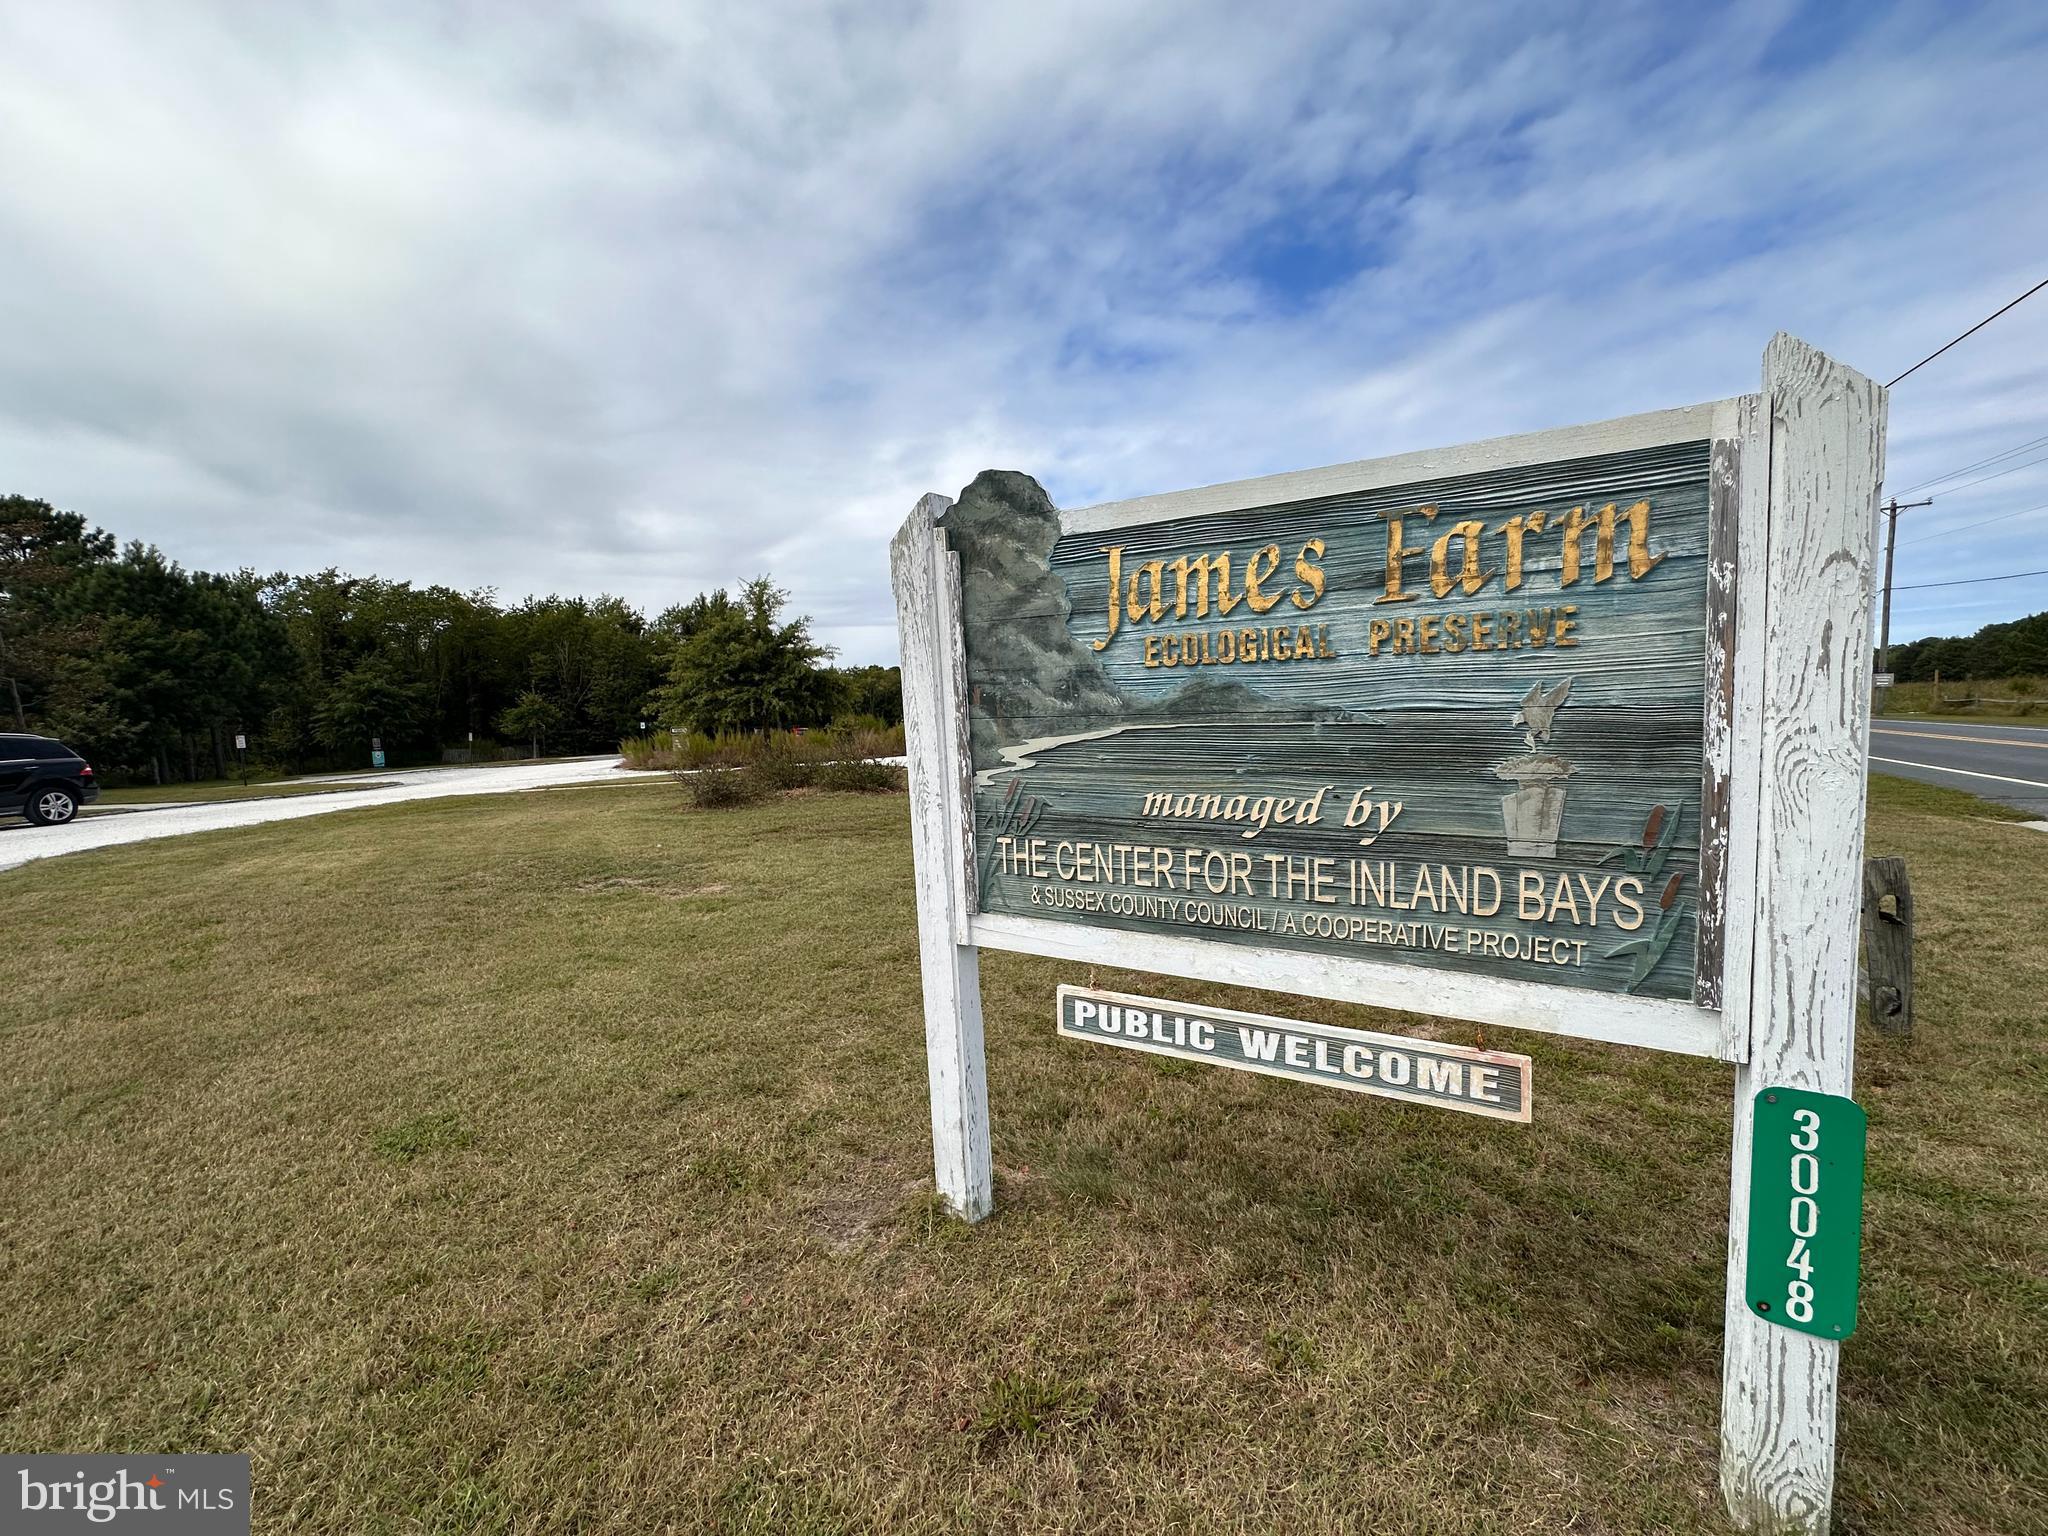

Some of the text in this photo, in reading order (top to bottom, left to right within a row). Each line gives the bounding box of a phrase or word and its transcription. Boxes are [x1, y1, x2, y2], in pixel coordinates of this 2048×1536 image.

[1090, 498, 1668, 651] James Farm
[1144, 605, 1580, 668] ECOLOGICAL PRESERVE
[1142, 785, 1403, 845] managed by
[997, 837, 1644, 930] THE CENTER FOR THE INLAND BAYS
[1031, 885, 1042, 905] &
[1045, 887, 1107, 912] SUSSEX
[1111, 893, 1180, 920] COUNTY
[1185, 900, 1268, 931] COUNCIL
[1283, 912, 1298, 934] A
[1303, 913, 1460, 952] COOPERATIVE
[1467, 929, 1587, 967] PROJECT
[1074, 999, 1502, 1100] PUBLIC WELCOME
[1786, 1109, 1821, 1323] 30048
